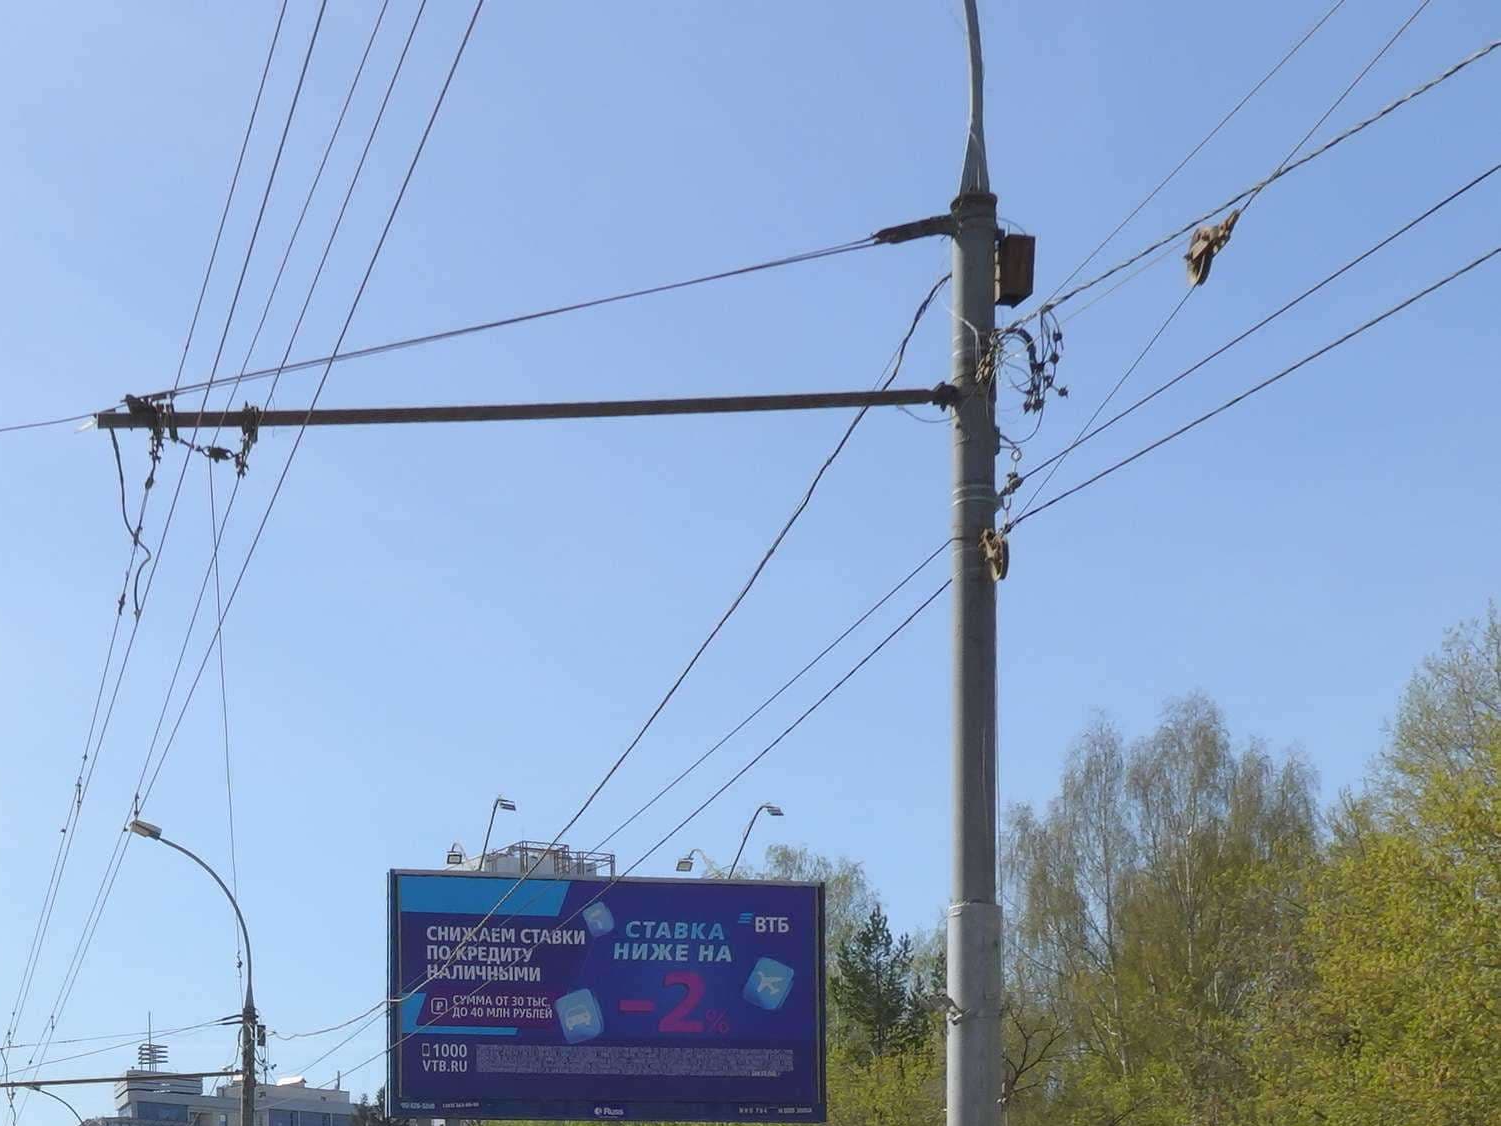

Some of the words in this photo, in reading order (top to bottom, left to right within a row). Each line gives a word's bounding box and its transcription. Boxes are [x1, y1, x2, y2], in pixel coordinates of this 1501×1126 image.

[625, 920, 725, 940] СТАВКА
[754, 916, 790, 933] ВТБ
[426, 925, 516, 943] СНИЖАЕМ
[520, 928, 586, 945] СТАВКИ
[426, 944, 450, 961] ПО
[456, 945, 534, 964] КРЕДИТУ
[613, 942, 689, 961] НИЖЕ
[698, 944, 733, 962] НА
[426, 964, 541, 982] НАЛИЧНЫМИ
[452, 994, 493, 1006] СУММА
[495, 996, 509, 1006] ОТ
[511, 996, 524, 1007] 30
[452, 1007, 468, 1018] ДО
[470, 1007, 484, 1018] 40
[486, 1007, 510, 1018] МЛН
[513, 1006, 553, 1019] РУБЛЕЙ
[432, 1043, 468, 1058] 1000
[422, 1059, 468, 1072] VTB.RU
